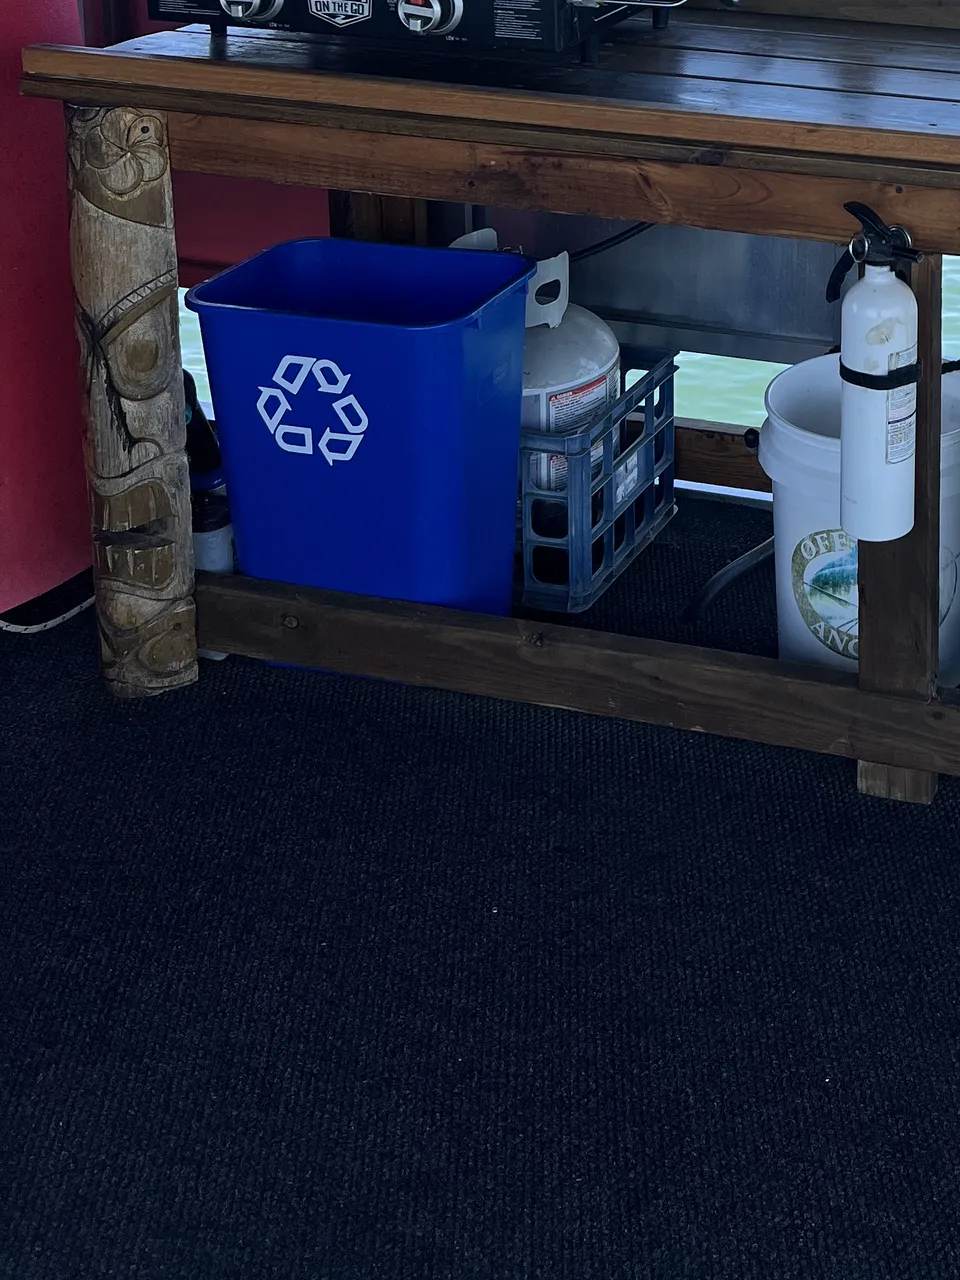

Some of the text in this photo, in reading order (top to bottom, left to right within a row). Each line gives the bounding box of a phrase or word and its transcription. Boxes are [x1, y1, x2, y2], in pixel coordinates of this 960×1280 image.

[315, 0, 365, 16] ON THE GO
